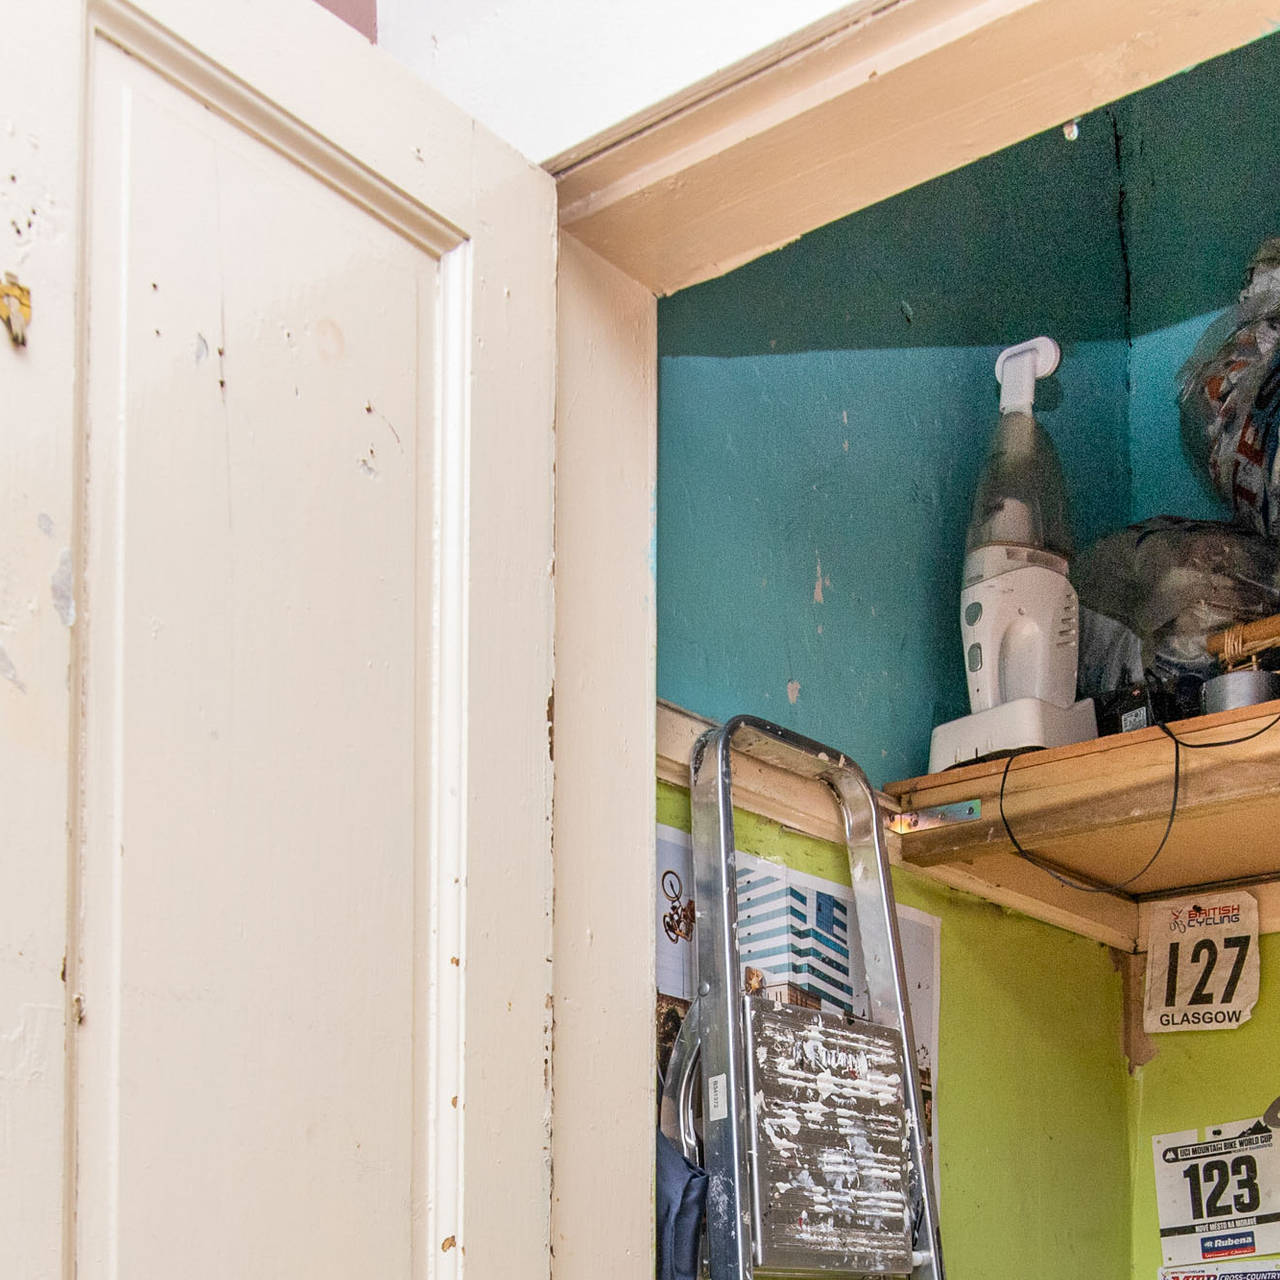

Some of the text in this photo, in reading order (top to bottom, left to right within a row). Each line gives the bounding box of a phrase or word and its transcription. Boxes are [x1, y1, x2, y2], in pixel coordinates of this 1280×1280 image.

[1187, 904, 1241, 919] BRITISH
[1187, 914, 1241, 928] CYCLING
[1164, 935, 1251, 1007] 127
[1159, 1010, 1242, 1026] GLASGOW
[1223, 1140, 1238, 1151] BIKE
[1238, 1136, 1260, 1148] WORLD
[1260, 1134, 1273, 1144] CUP
[1183, 1154, 1261, 1221] 123
[1214, 1236, 1253, 1248] Rubena
